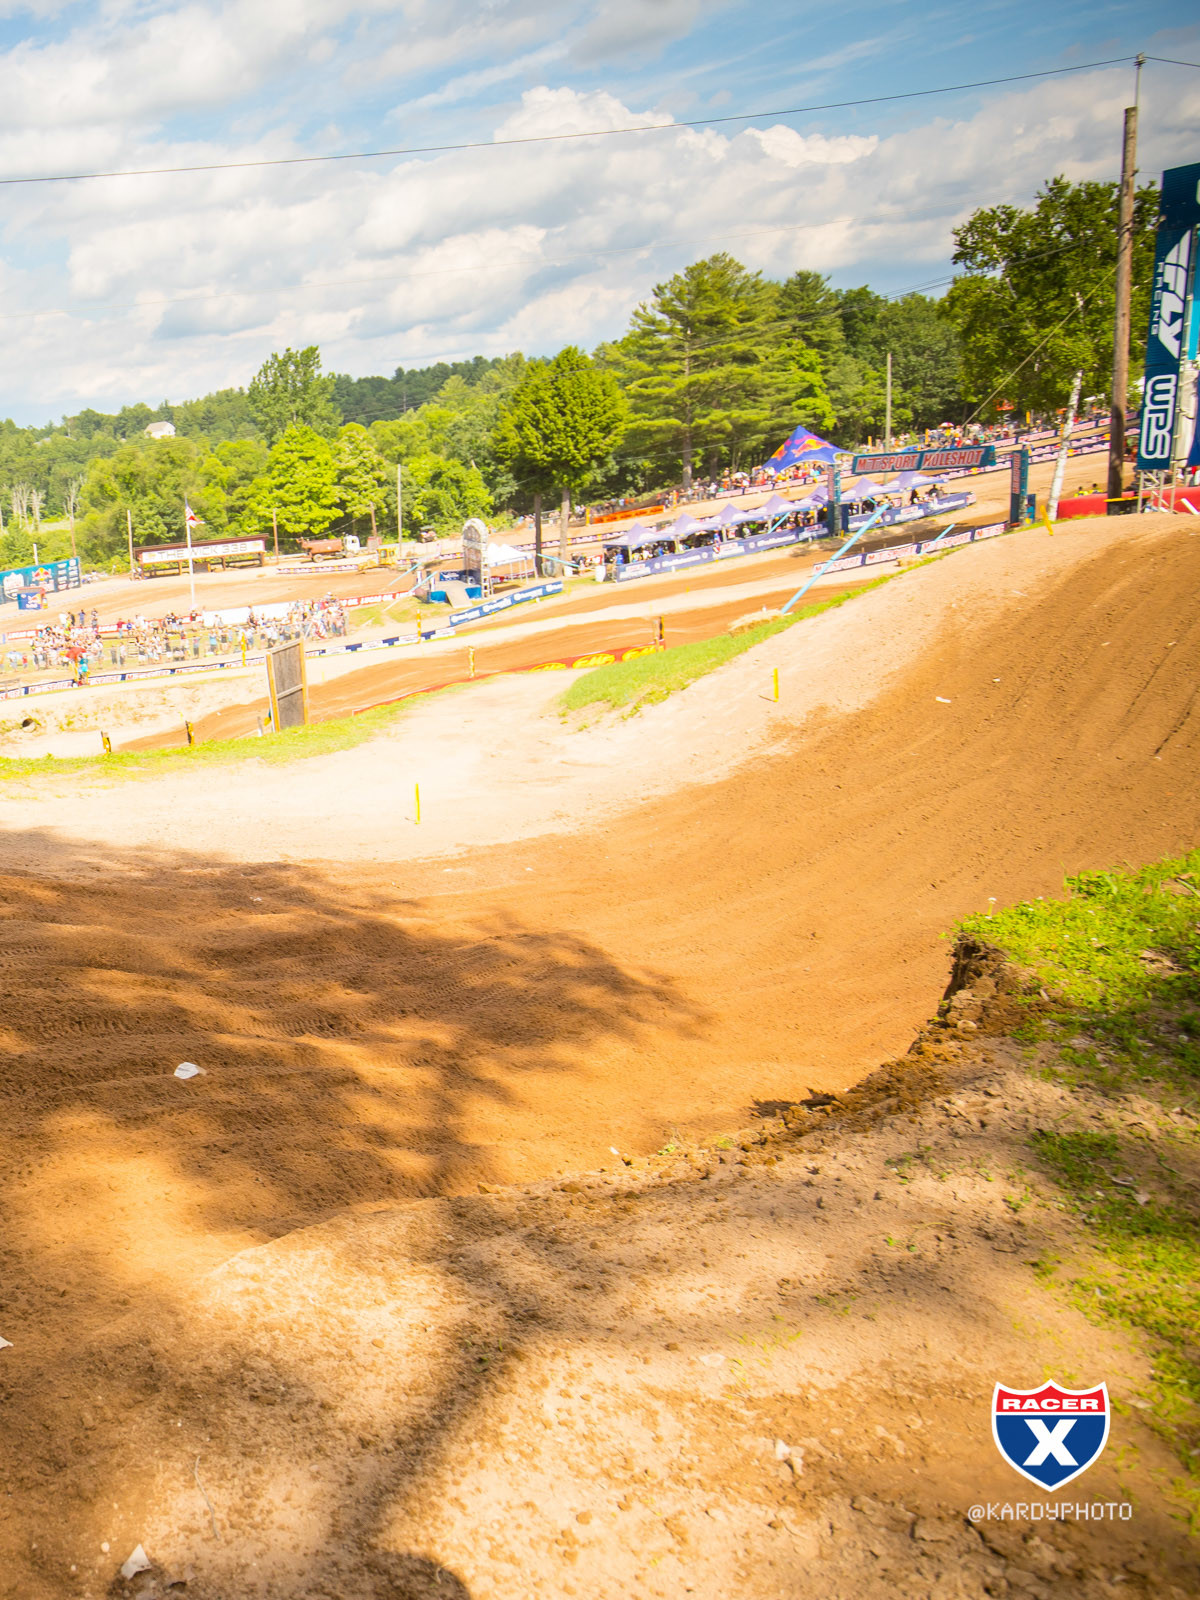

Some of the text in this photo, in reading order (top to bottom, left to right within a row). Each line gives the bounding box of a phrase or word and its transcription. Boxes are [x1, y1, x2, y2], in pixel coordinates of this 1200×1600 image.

[922, 448, 986, 469] HOLESHOT
[158, 549, 184, 560] THE
[221, 543, 248, 553] 338
